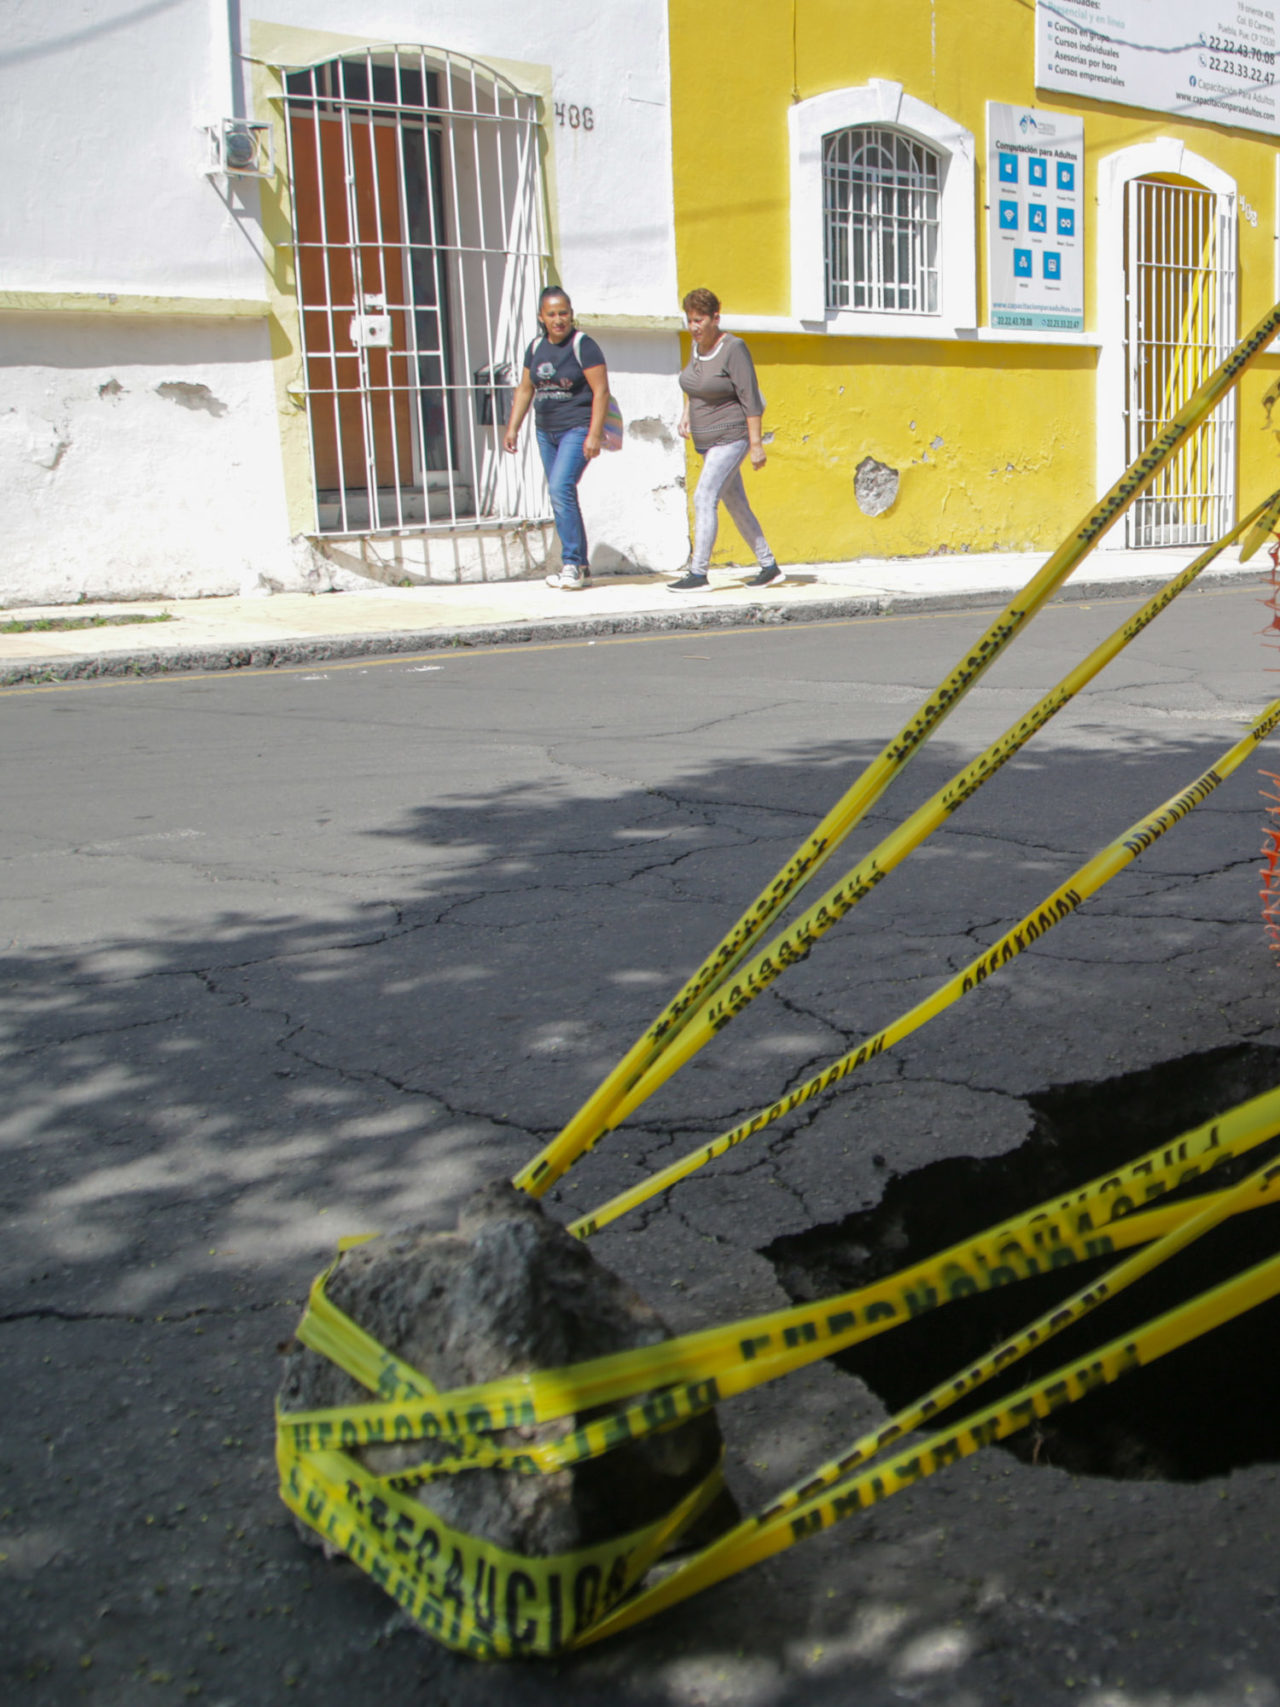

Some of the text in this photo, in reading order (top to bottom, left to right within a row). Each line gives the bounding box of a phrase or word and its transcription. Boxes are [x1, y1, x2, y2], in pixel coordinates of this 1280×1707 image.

[1055, 22, 1110, 42] Cursos en grupo
[1055, 36, 1120, 58] Cursos individuales
[1209, 35, 1275, 65] 22.22.43.70.08
[1055, 65, 1125, 87] Cursos empresariales
[1088, 58, 1100, 68] por
[1102, 61, 1117, 72] hora
[1209, 57, 1275, 85] 22.23.33.22.47
[1176, 91, 1275, 121] www.capacitacionparaadultos.com
[1239, 88, 1251, 100] Para
[1253, 91, 1275, 106] Adultos
[555, 102, 594, 131] 406
[995, 140, 1078, 161] Computación para Adultos
